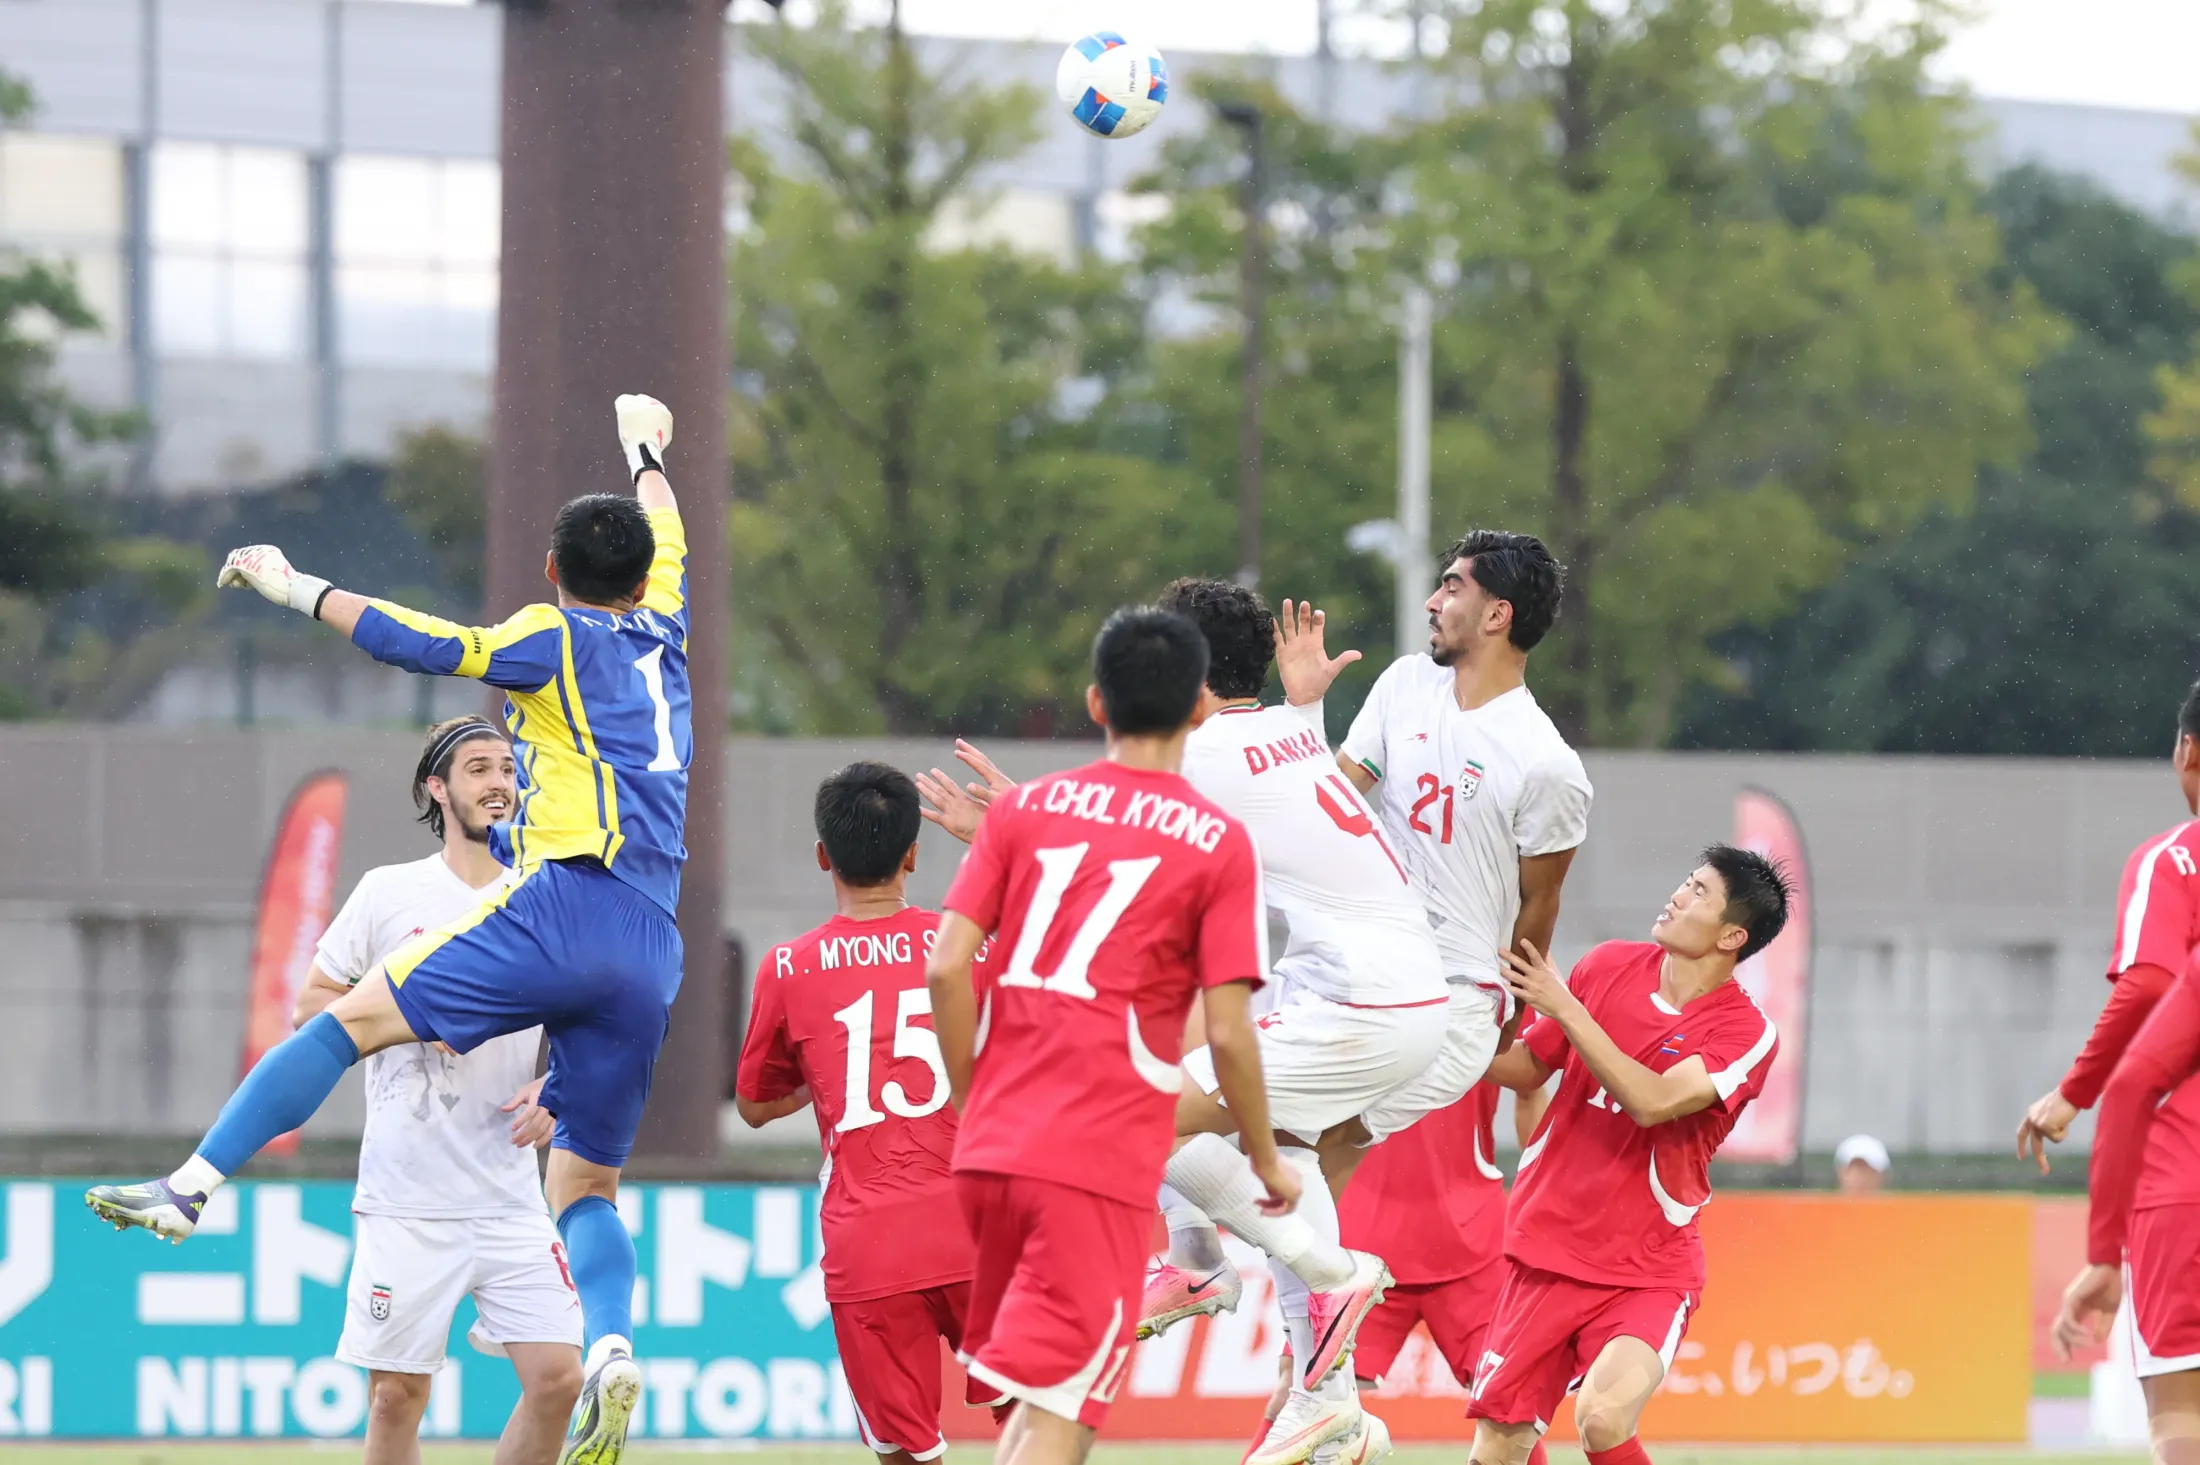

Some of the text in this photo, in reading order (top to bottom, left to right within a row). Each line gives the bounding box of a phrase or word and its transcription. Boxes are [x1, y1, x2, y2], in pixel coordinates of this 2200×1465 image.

[634, 643, 681, 772] 1
[1044, 779, 1116, 825] CHOL
[1120, 790, 1227, 854] KYONG
[1314, 774, 1409, 886] 4
[1409, 772, 1454, 844] 21
[819, 932, 912, 971] MYONG
[998, 841, 1161, 1000] 11
[833, 987, 952, 1133] 15
